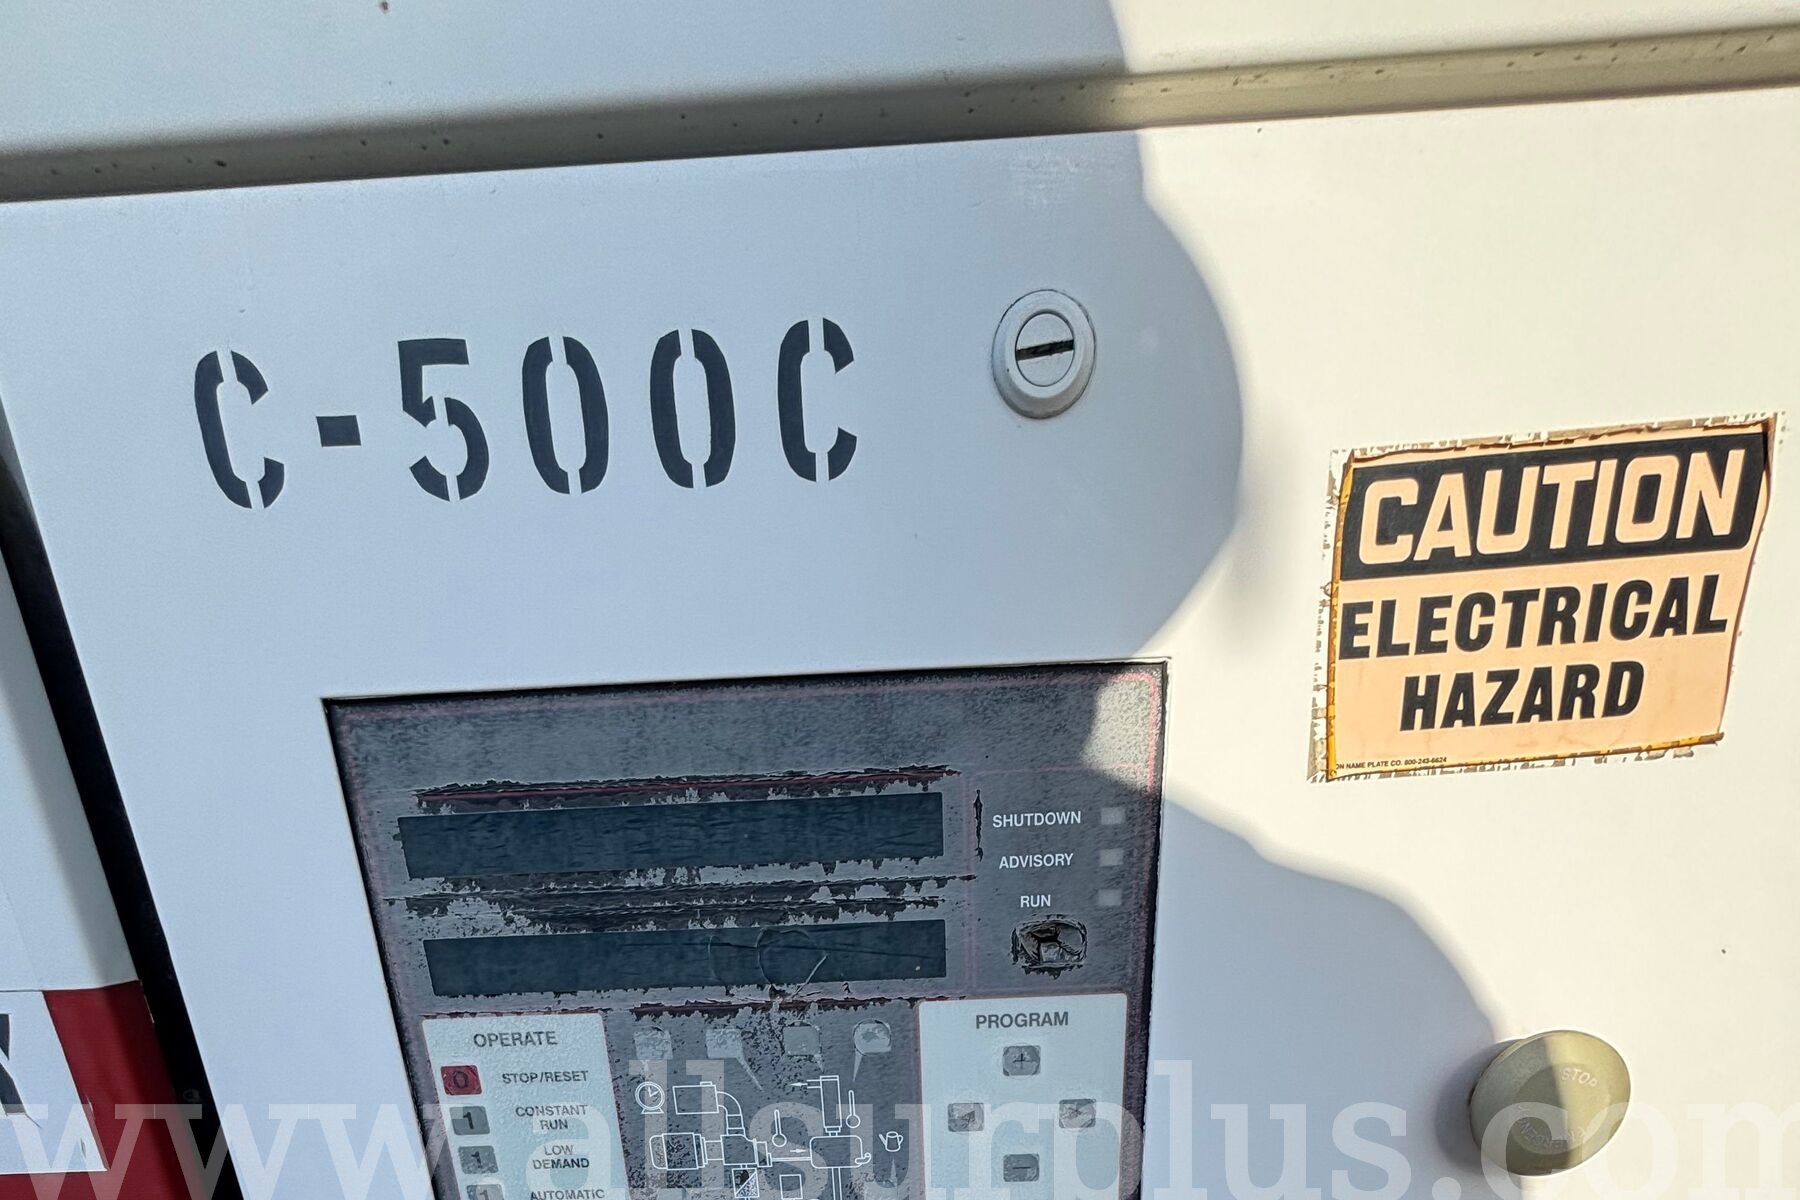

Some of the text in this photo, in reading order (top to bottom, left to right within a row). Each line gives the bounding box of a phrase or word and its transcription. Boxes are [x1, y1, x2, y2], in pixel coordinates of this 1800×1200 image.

[195, 318, 857, 509] C-500C
[1359, 449, 1745, 565] CAUTION
[1339, 574, 1727, 660] ELECTRICAL
[1400, 661, 1644, 731] HAZARD
[992, 811, 1081, 828] SHUTDOWN
[999, 852, 1073, 869] ADVISORY
[1020, 895, 1051, 907] RUN
[976, 1012, 1068, 1029] PROGRAM
[474, 1031, 558, 1047] OPERATE
[502, 1070, 588, 1084] STOP/RESET
[1561, 1067, 1598, 1087] STOP
[516, 1105, 587, 1117] CONSTANT
[540, 1120, 568, 1130] RUN
[544, 1145, 573, 1155] LOW
[533, 1158, 589, 1169] DEMAND
[530, 1190, 605, 1200] AUTOMATIC
